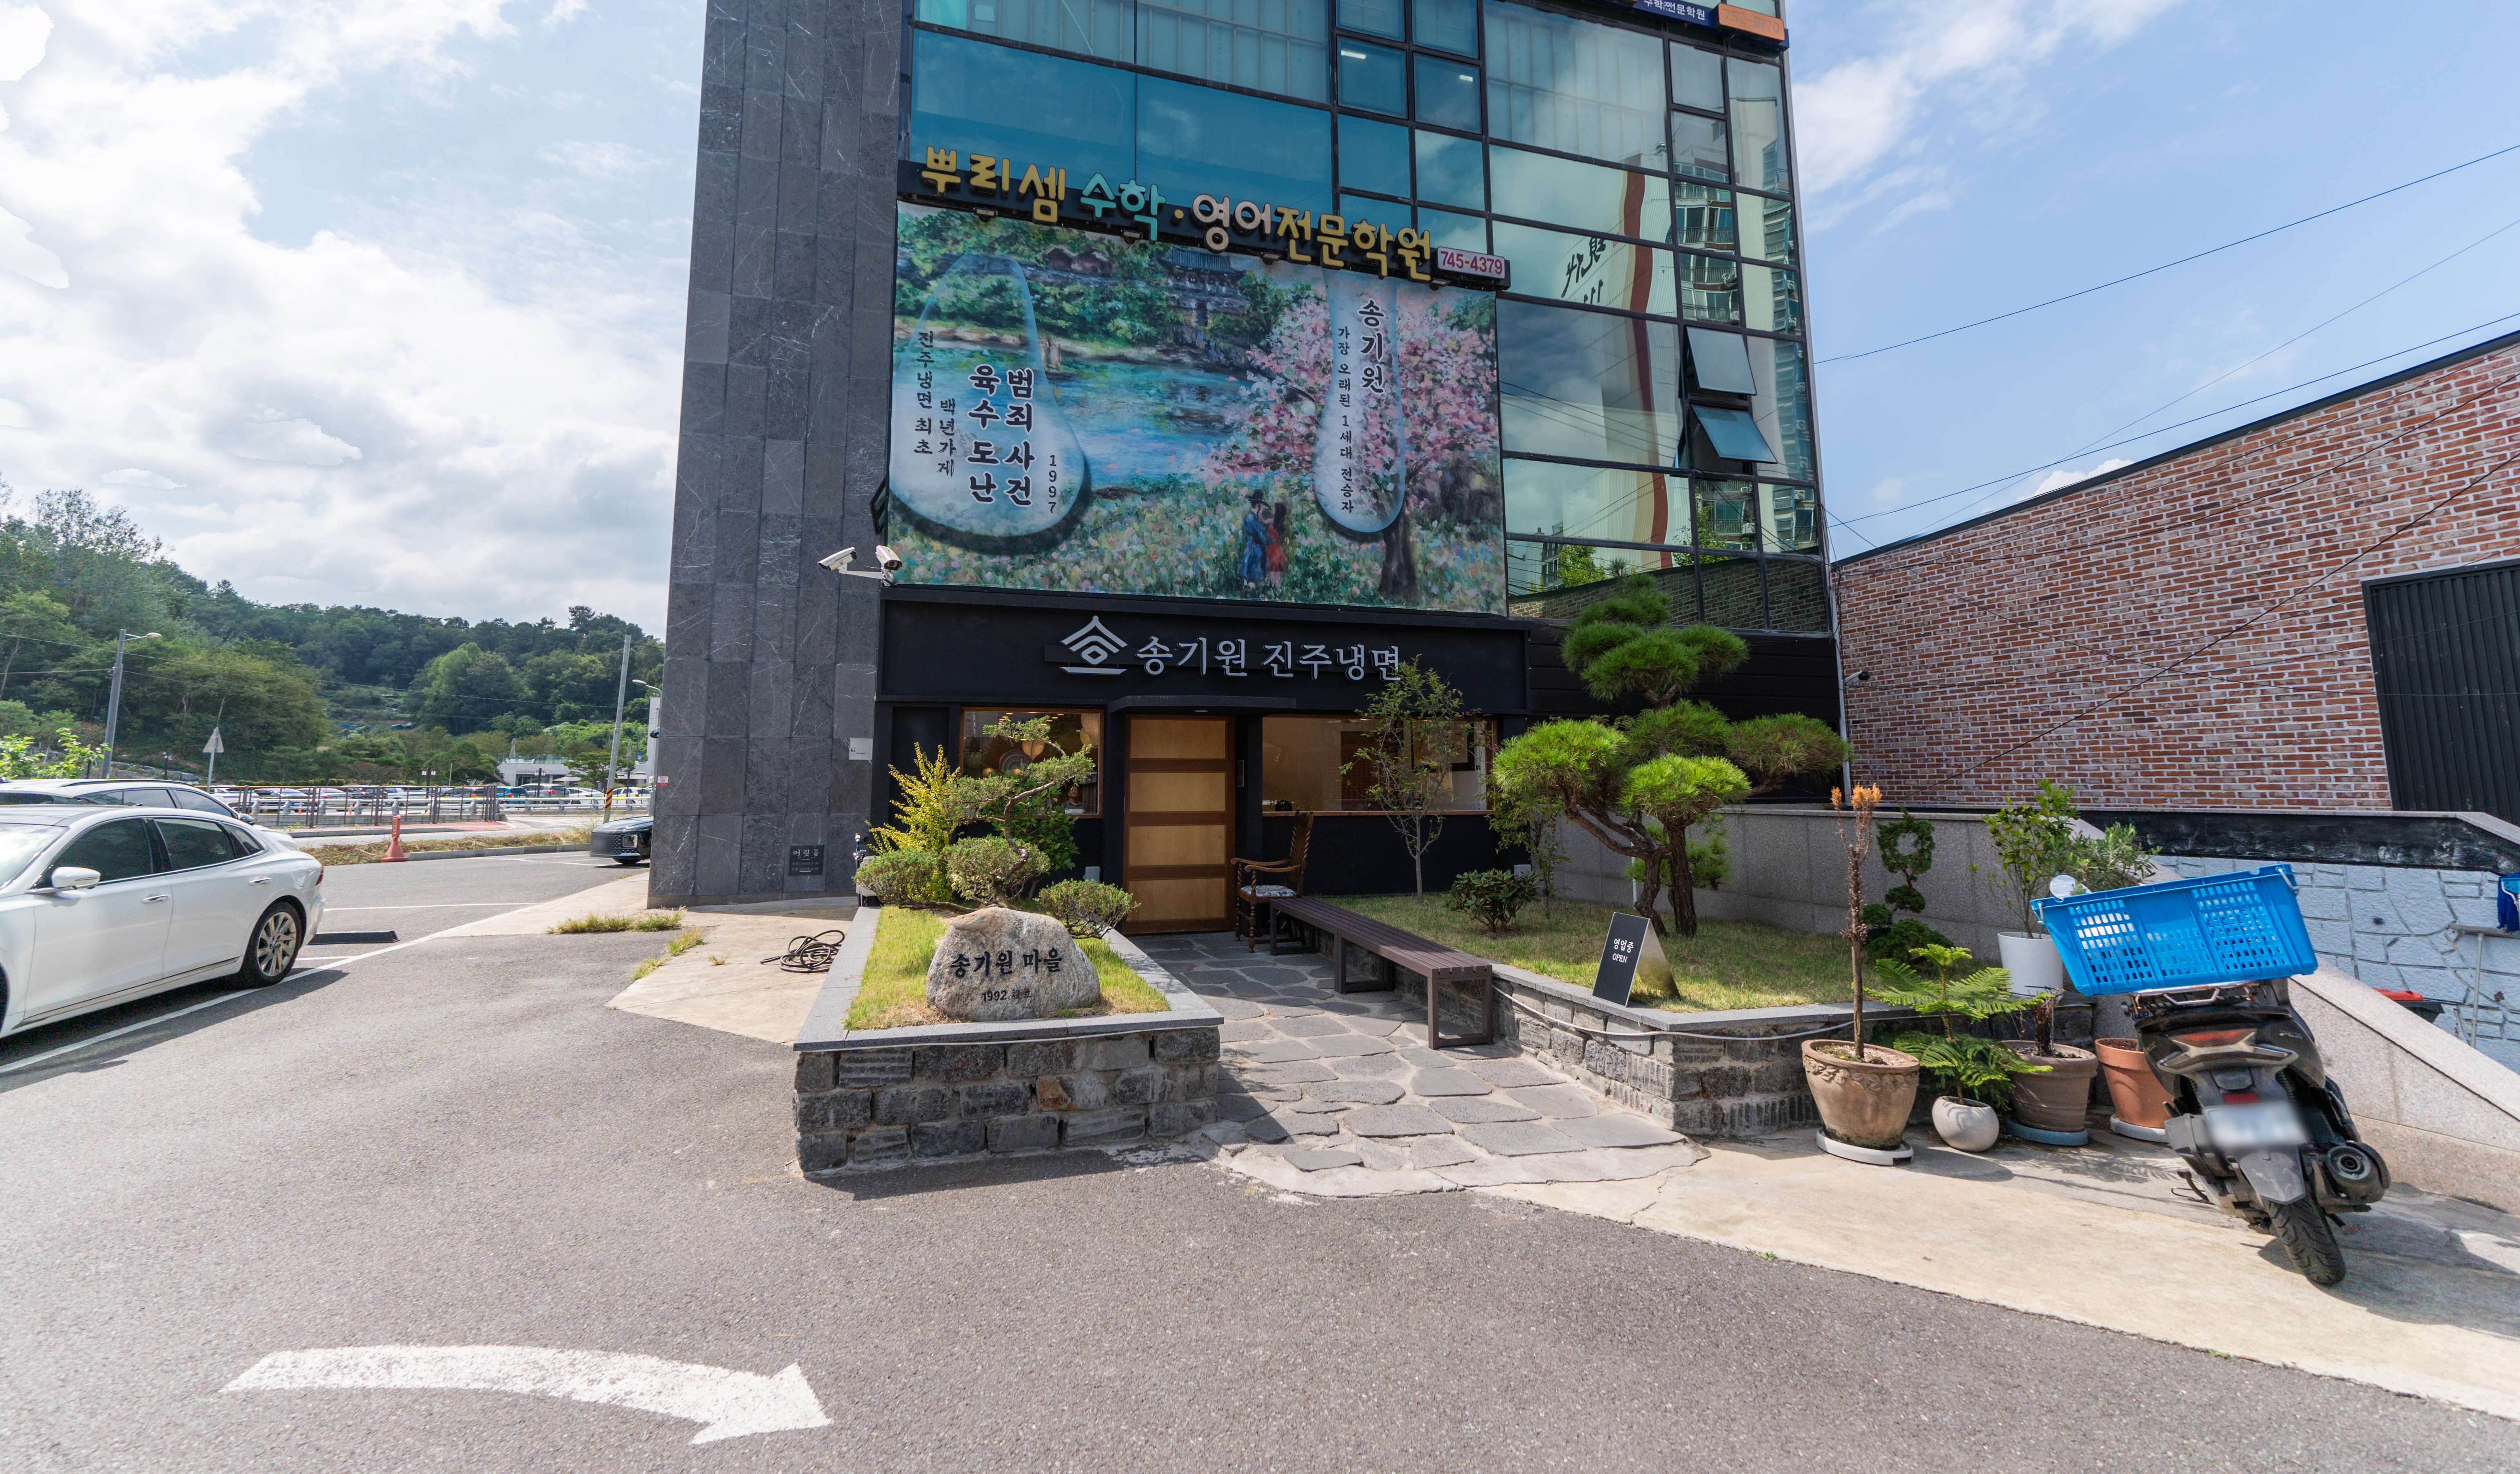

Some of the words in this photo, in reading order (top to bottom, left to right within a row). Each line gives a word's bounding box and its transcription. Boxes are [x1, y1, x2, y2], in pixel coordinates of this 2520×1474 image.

[921, 145, 1066, 223] 뿌리셈
[1440, 250, 1503, 275] 745-4379
[1337, 326, 1350, 355] 가장
[1359, 299, 1385, 393] 송기원
[916, 330, 935, 409] 진주냉면
[1338, 364, 1351, 408] 오래된
[968, 365, 1000, 429] 육수
[1005, 368, 1033, 433] 범죄
[914, 417, 933, 455] 최초
[967, 440, 999, 503] 도난
[1004, 441, 1036, 506] 사건
[1048, 455, 1057, 514] 1997
[1340, 467, 1354, 514] 전승자
[1137, 636, 1248, 677] 송기원
[1263, 641, 1401, 682] 진주냉면
[951, 950, 1013, 978] 송기원
[1023, 948, 1062, 973] 마을
[1612, 953, 1628, 963] OPEN
[1614, 938, 1634, 953] 영업중
